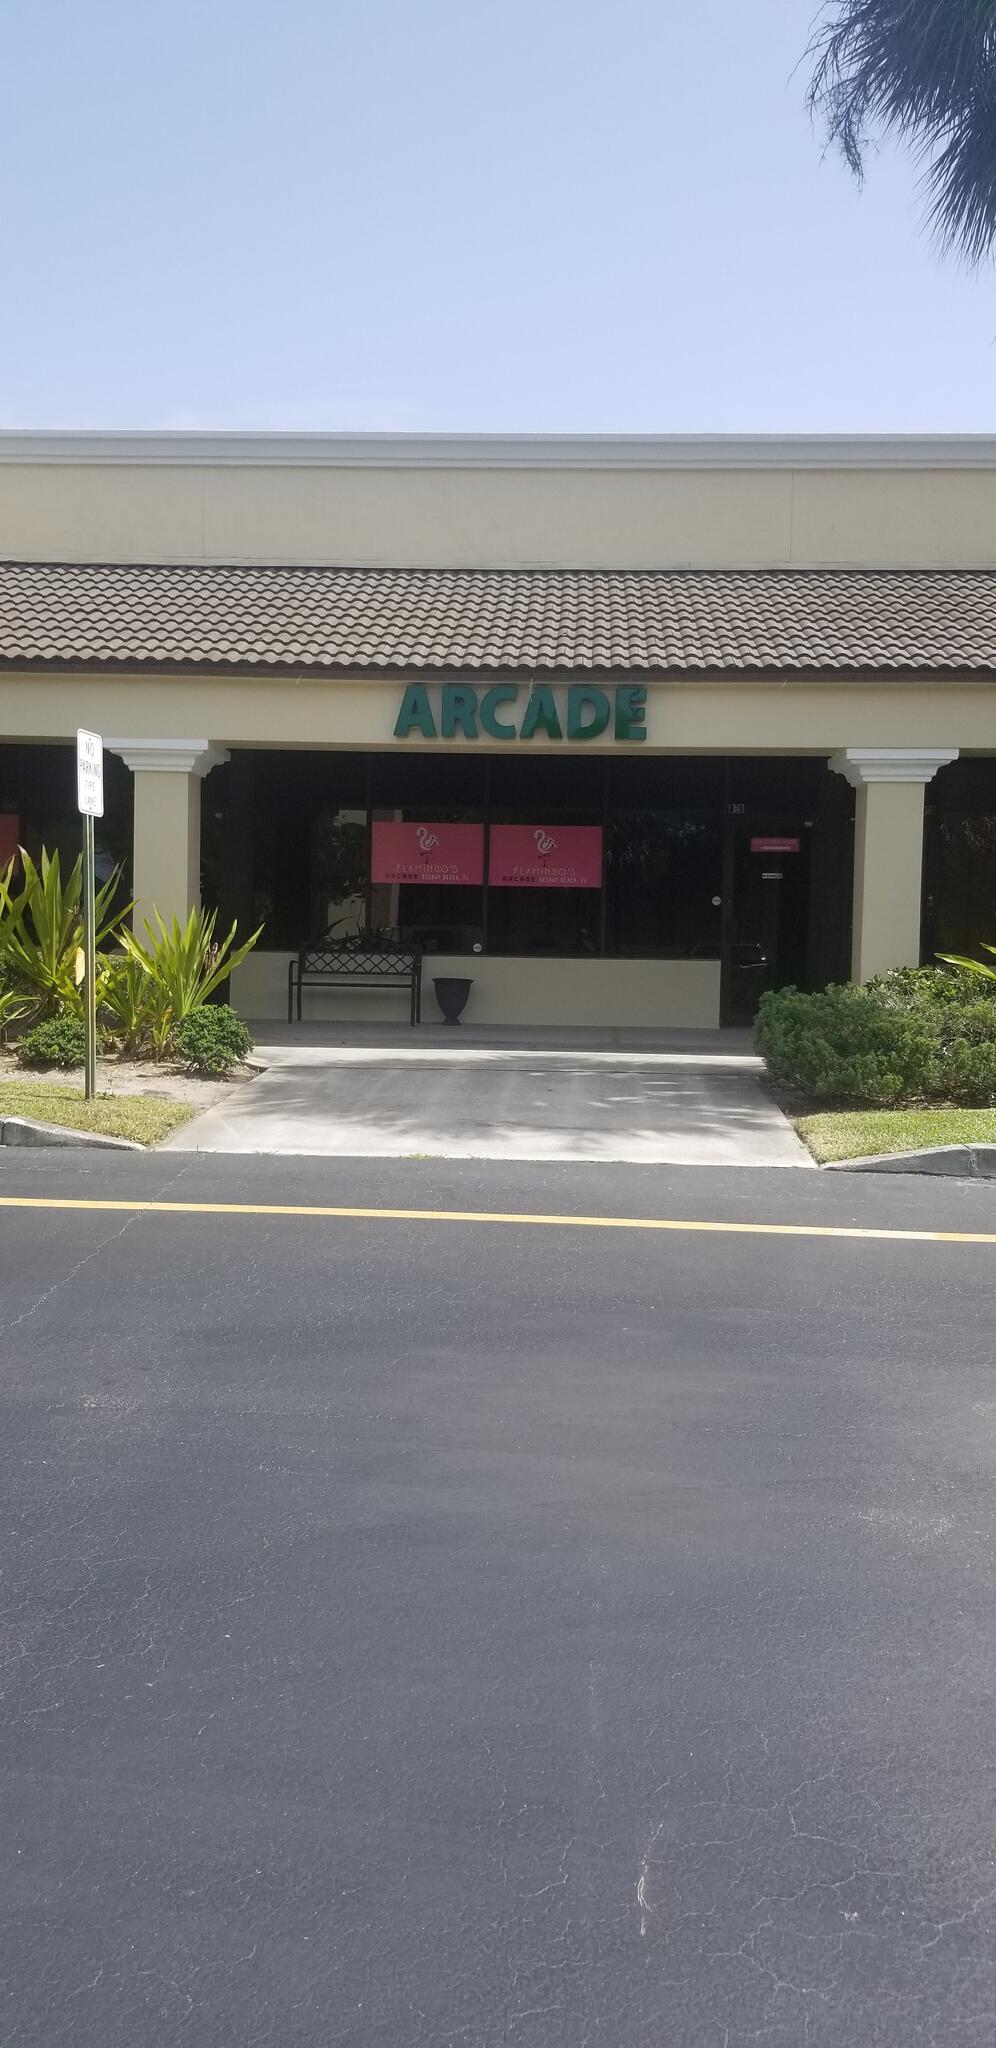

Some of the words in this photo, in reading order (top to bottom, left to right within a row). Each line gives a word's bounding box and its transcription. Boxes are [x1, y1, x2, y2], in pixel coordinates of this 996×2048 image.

[393, 683, 648, 741] ARCADE
[86, 742, 95, 757] NO
[80, 758, 101, 778] PARKING
[396, 864, 458, 873] FLAMINGO'S
[513, 867, 576, 876] FLAMINGO'S
